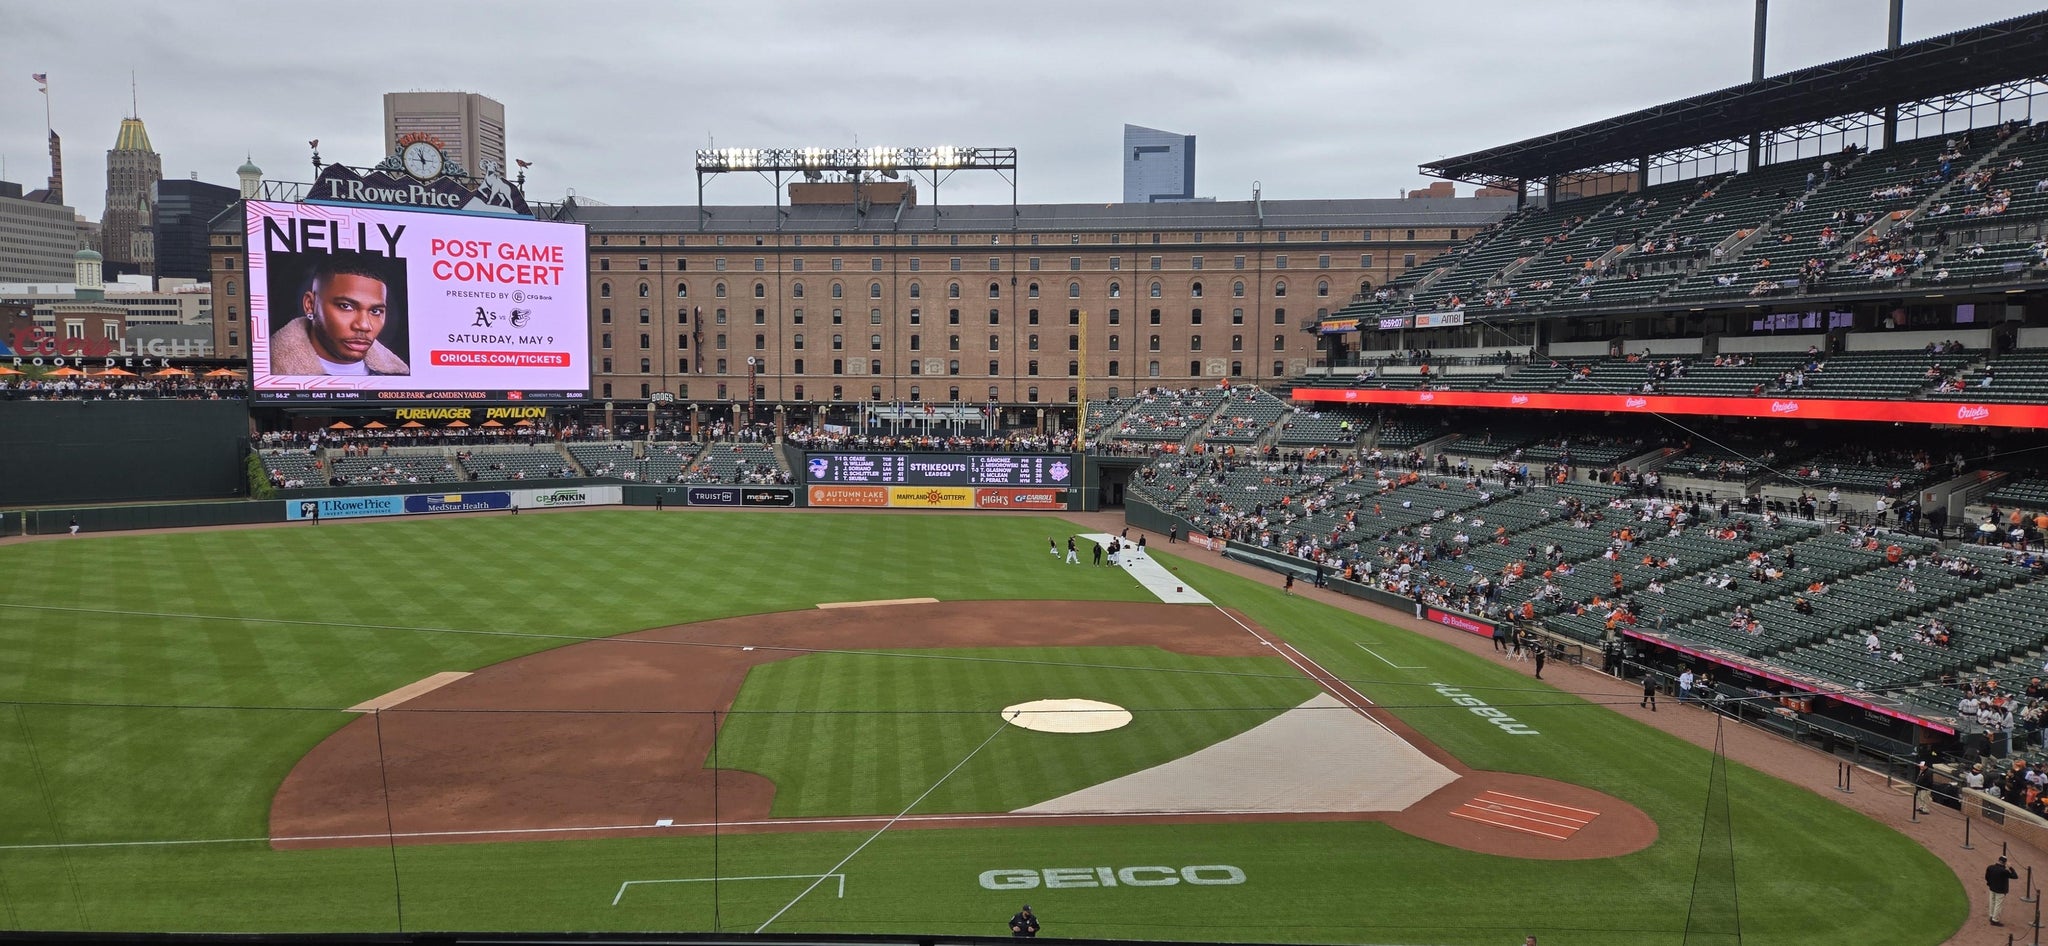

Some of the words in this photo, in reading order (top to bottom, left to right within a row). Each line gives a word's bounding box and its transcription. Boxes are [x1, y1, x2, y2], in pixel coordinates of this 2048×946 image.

[263, 216, 407, 258] NELLY
[432, 238, 492, 258] POST
[498, 243, 564, 262] GAME
[432, 260, 564, 286] CONCERT
[446, 290, 496, 299] PRESENTED
[1380, 318, 1402, 328] 10:59:07
[11, 326, 114, 356] Coors
[120, 338, 209, 357] LIGHT
[448, 334, 514, 345] SATURDAY,
[519, 336, 543, 345] MAY
[547, 336, 553, 344] 9
[14, 358, 83, 367] ROOF
[106, 358, 170, 367] DECK
[440, 354, 562, 365] ORIOLES.COM/TICKETS
[1772, 401, 1798, 413] Orioles
[1958, 406, 1989, 420] Orioles
[396, 408, 471, 419] PUREWAGER
[486, 408, 546, 418] PAVILION
[428, 502, 461, 512] MedStar
[463, 502, 489, 510] Health
[1451, 617, 1479, 632] Budweiser
[979, 864, 1247, 890] GEICO
